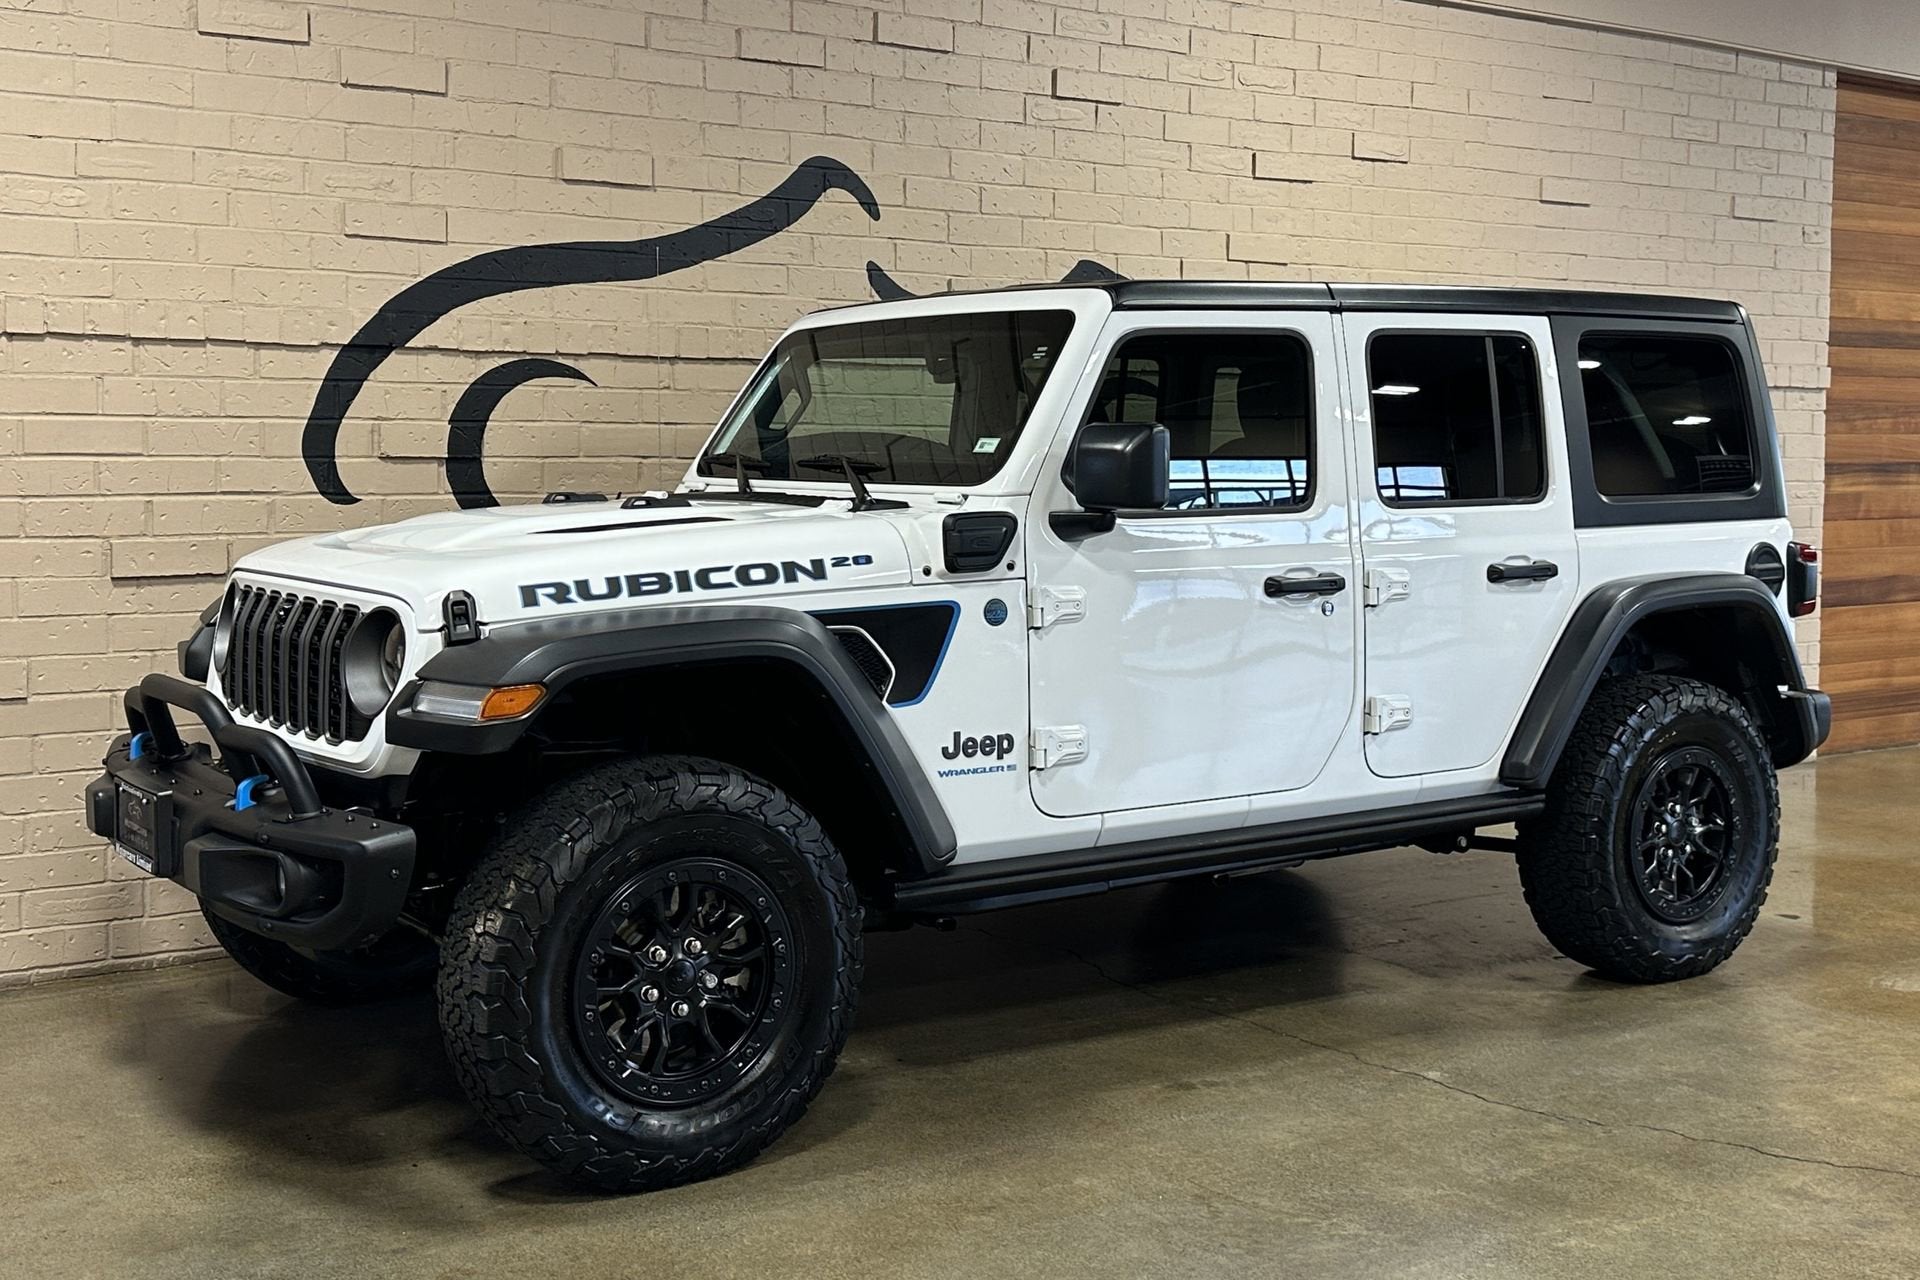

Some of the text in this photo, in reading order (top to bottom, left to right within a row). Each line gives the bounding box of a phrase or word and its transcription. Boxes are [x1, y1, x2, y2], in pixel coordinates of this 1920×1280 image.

[518, 558, 828, 608] RUBICON
[941, 730, 1015, 760] Jeep
[937, 764, 1005, 778] WRANGLER
